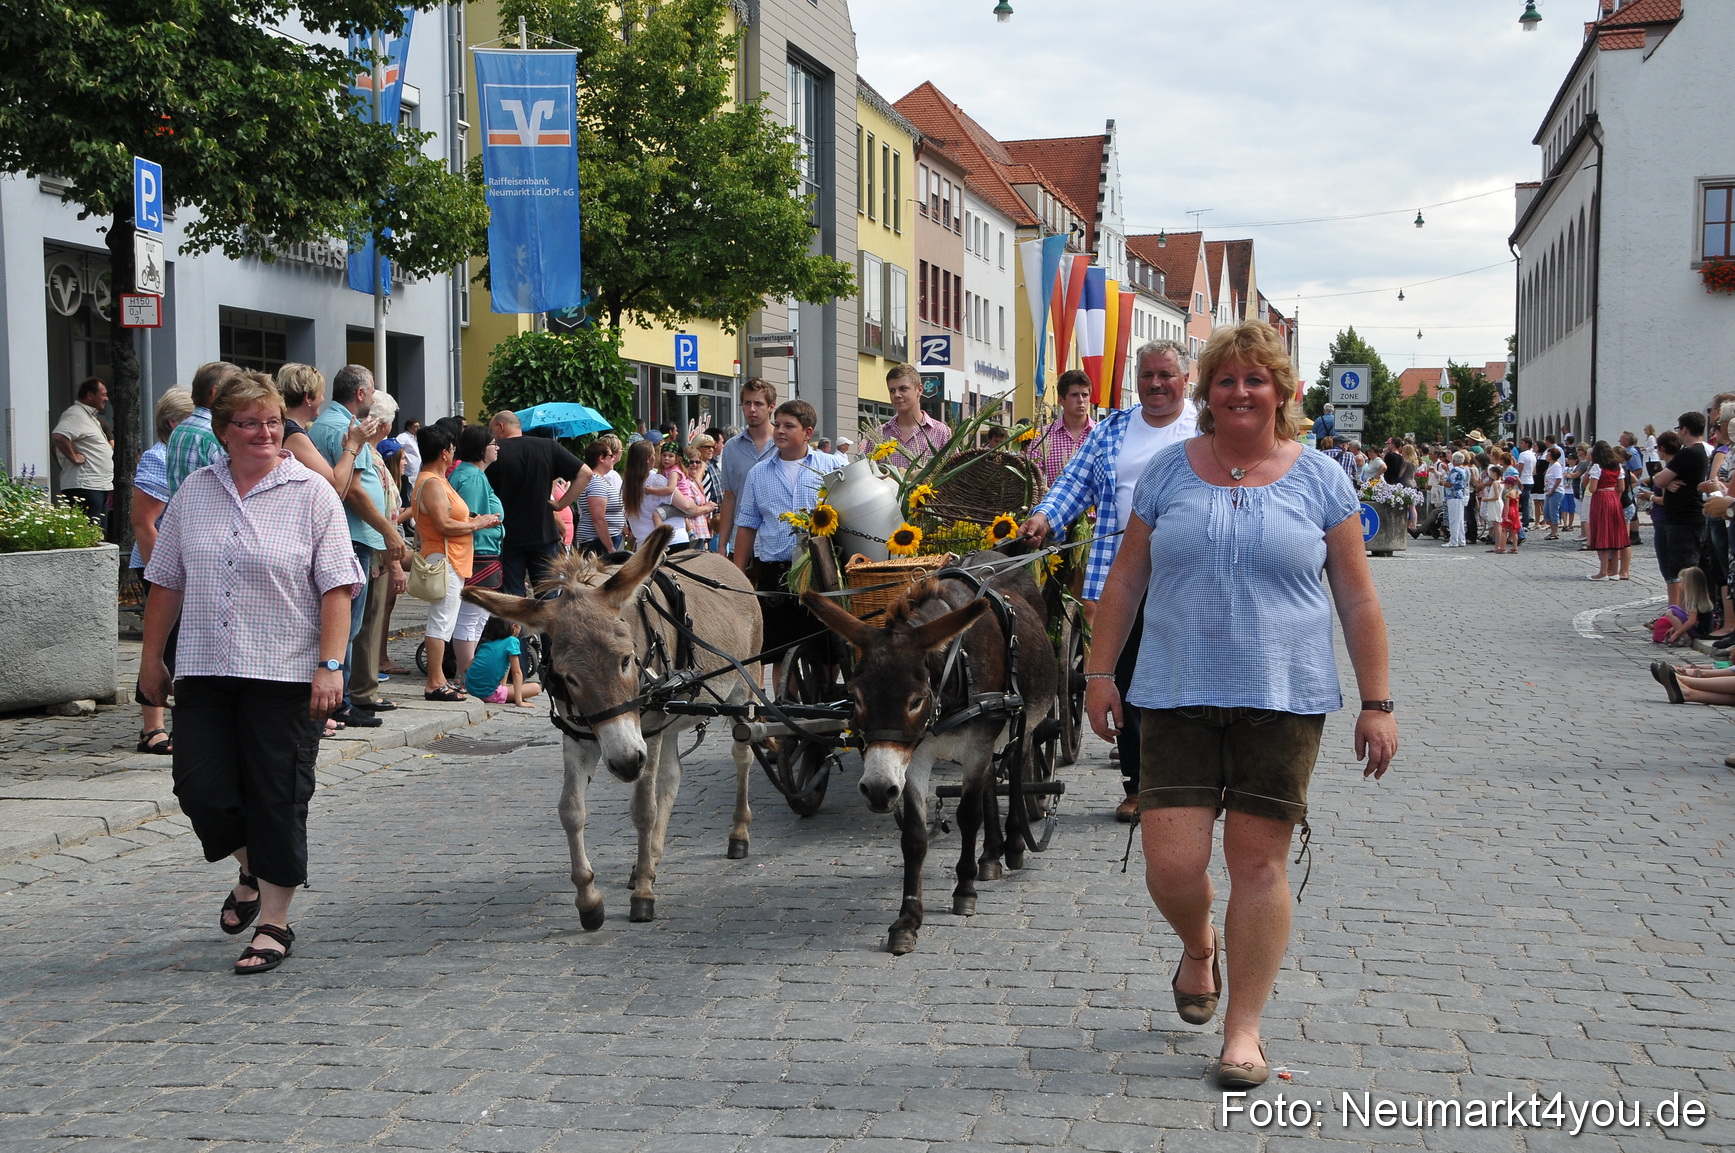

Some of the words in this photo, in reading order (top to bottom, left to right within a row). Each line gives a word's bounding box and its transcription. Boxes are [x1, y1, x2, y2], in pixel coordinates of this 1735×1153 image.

[488, 176, 550, 186] Raiffeisenbank
[141, 169, 156, 221] P
[489, 188, 530, 197] Neumarkt
[563, 188, 575, 197] eG
[145, 242, 155, 253] nur
[130, 297, 150, 306] H150
[680, 338, 694, 367] P
[923, 380, 935, 393] G2
